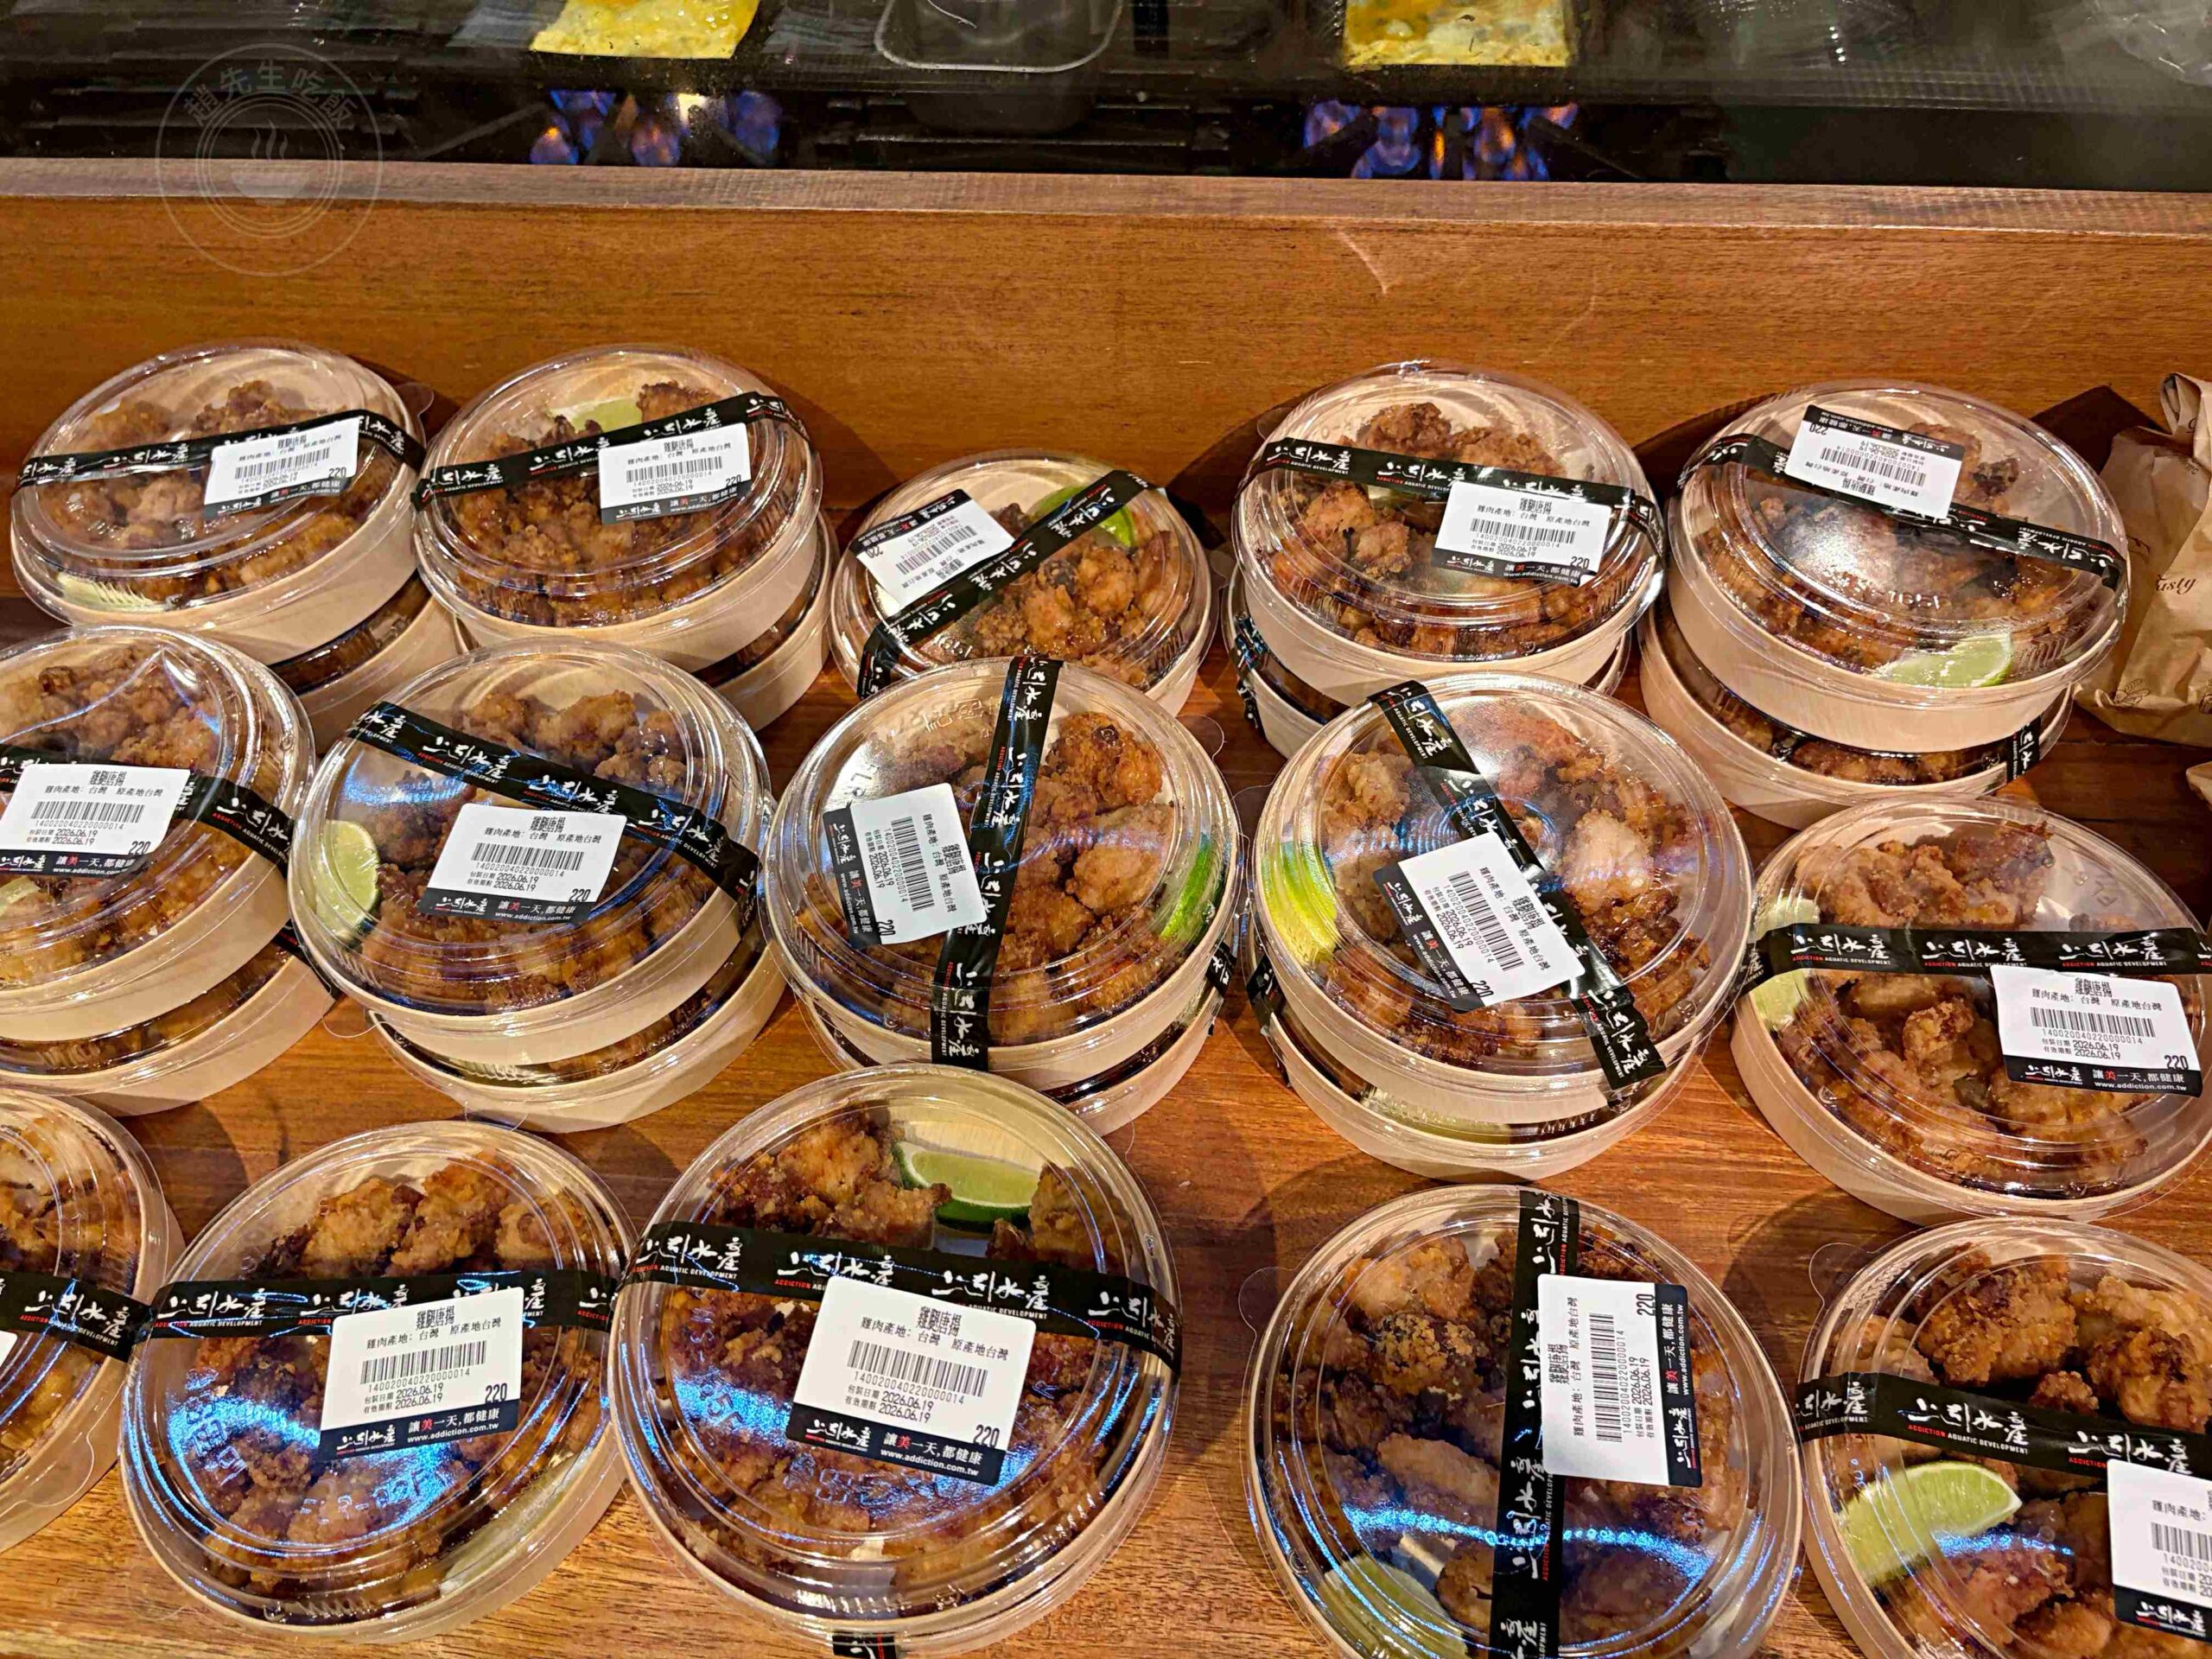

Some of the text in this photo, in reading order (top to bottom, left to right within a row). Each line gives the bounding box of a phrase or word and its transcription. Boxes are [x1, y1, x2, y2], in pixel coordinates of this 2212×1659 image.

[1808, 423, 1827, 435] 220
[726, 474, 743, 486] 220
[1570, 556, 1589, 568] 220
[127, 840, 152, 855] 220
[496, 873, 540, 884] 2026.06.19
[569, 888, 591, 903] 220
[493, 909, 573, 924] www.addiction.com.tw
[1444, 908, 1474, 947] 2026.06.19
[877, 918, 896, 938] 220
[1435, 912, 1465, 950] 2026.06.19
[1791, 933, 1889, 959] 上引水產
[1922, 938, 2025, 962] 上引水產
[2059, 936, 2164, 961] 上引水產
[1411, 931, 1458, 1000] www.addiction.com.tw
[1470, 978, 1494, 1000] 220
[2072, 1039, 2120, 1051] 2026.06.19
[2074, 1048, 2122, 1059] 2026.06.19
[2163, 1055, 2190, 1071] 220
[2092, 1078, 2188, 1094] www.addiction.com.tw
[636, 1234, 743, 1271] 上引水產
[660, 1265, 738, 1280] AQUATIC DEVELOPMENT
[775, 1279, 811, 1288] ADDICTION
[931, 1270, 1049, 1311] 上引水產
[24, 1291, 130, 1338] 上引水產
[157, 1288, 266, 1319] 上引水產
[1635, 1293, 1656, 1315] 220
[20, 1314, 118, 1346] ADDICTION DEVELOPMENT
[1087, 1319, 1151, 1340] ADDICTION AQUATIC
[1675, 1305, 1689, 1395] www.addiction.com.tw
[1629, 1355, 1643, 1404] 2026.06.19
[1640, 1357, 1654, 1405] 2026.06.19
[396, 1392, 444, 1410] 2026.06.19
[397, 1382, 445, 1400] 2026.06.19
[486, 1382, 508, 1403] 220
[880, 1389, 934, 1412] 2026.06.19
[877, 1402, 931, 1424] 2026.06.19
[1907, 1398, 2029, 1446] 上引水產
[406, 1422, 498, 1443] www.addiction.com.tw
[972, 1423, 1000, 1447] 220
[1909, 1425, 2029, 1454] ADDICTION AQUATIC DEVELOPMENT
[882, 1431, 983, 1466] 讓美一天,都健康
[2068, 1431, 2193, 1474] 上引水產
[880, 1448, 979, 1477] www.addiction.com.tw
[2068, 1457, 2107, 1467] ADDICTION
